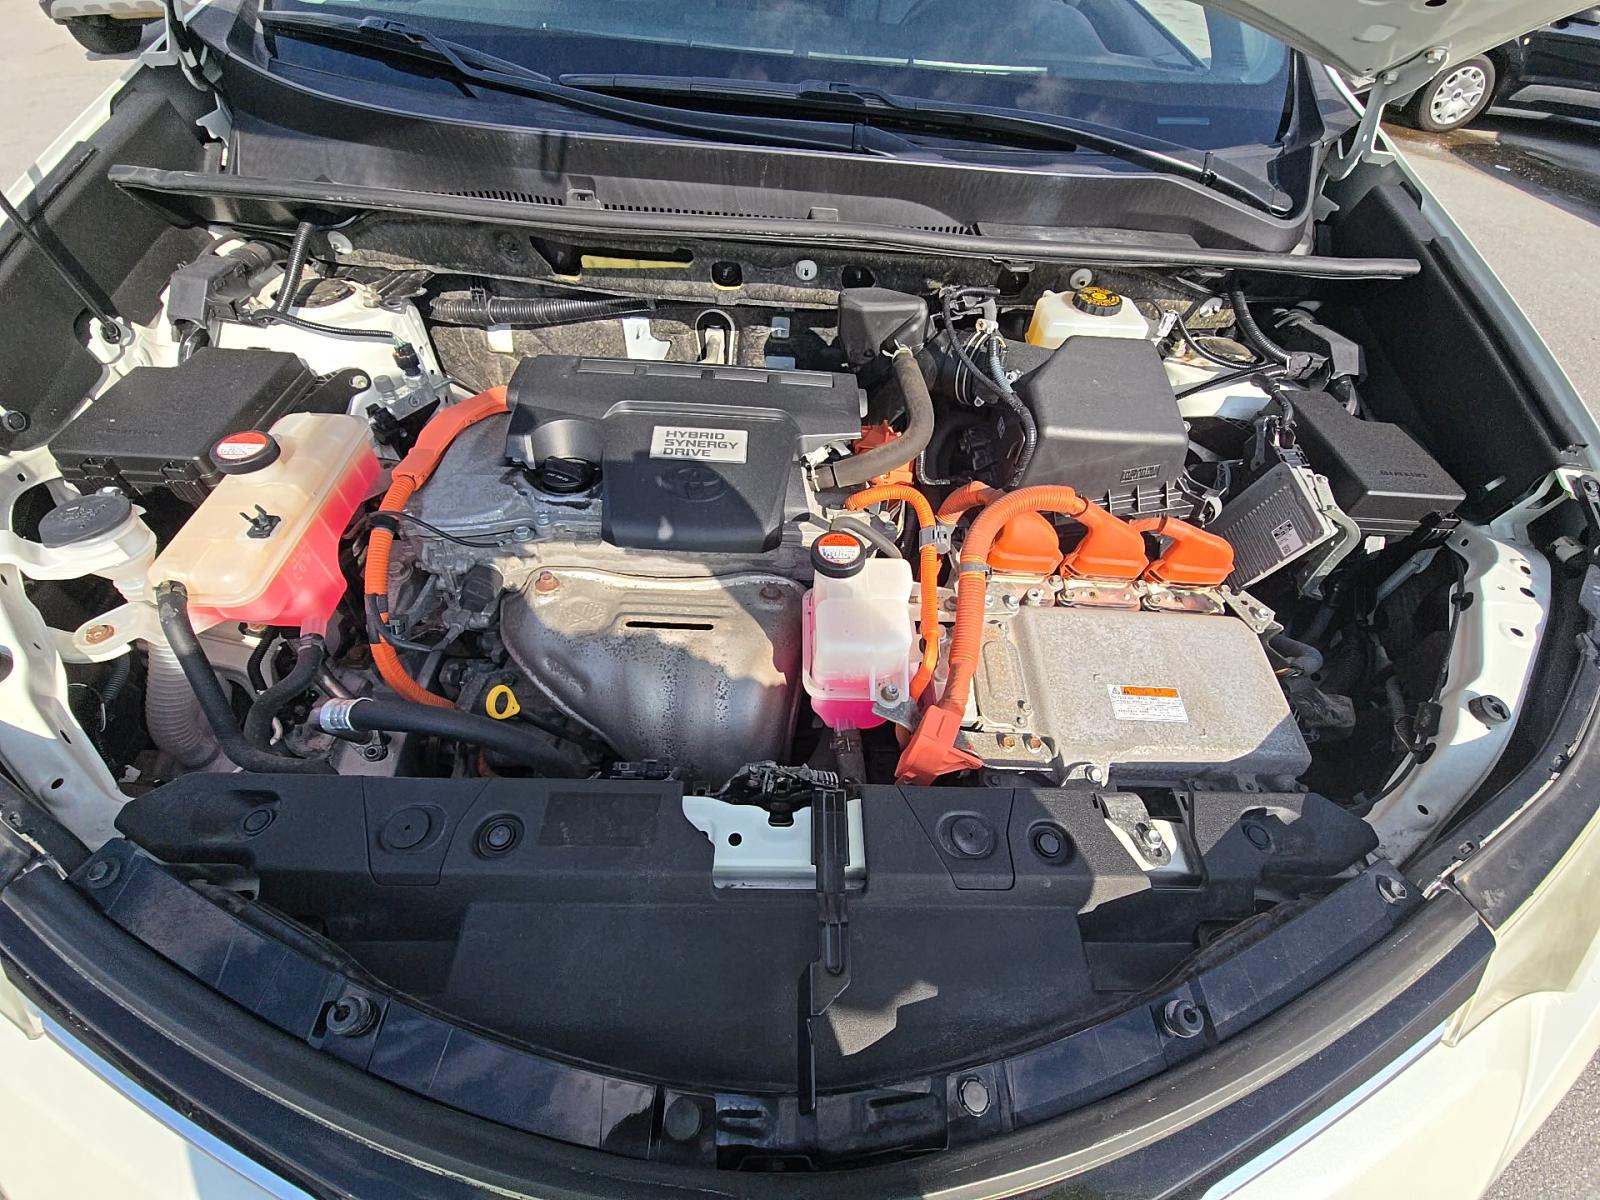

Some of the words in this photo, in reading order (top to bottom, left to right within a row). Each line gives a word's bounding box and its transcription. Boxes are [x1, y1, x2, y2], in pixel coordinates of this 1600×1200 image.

[665, 430, 725, 440] HYBRID
[664, 438, 738, 449] SYNERGY
[663, 447, 711, 457] DRIVE
